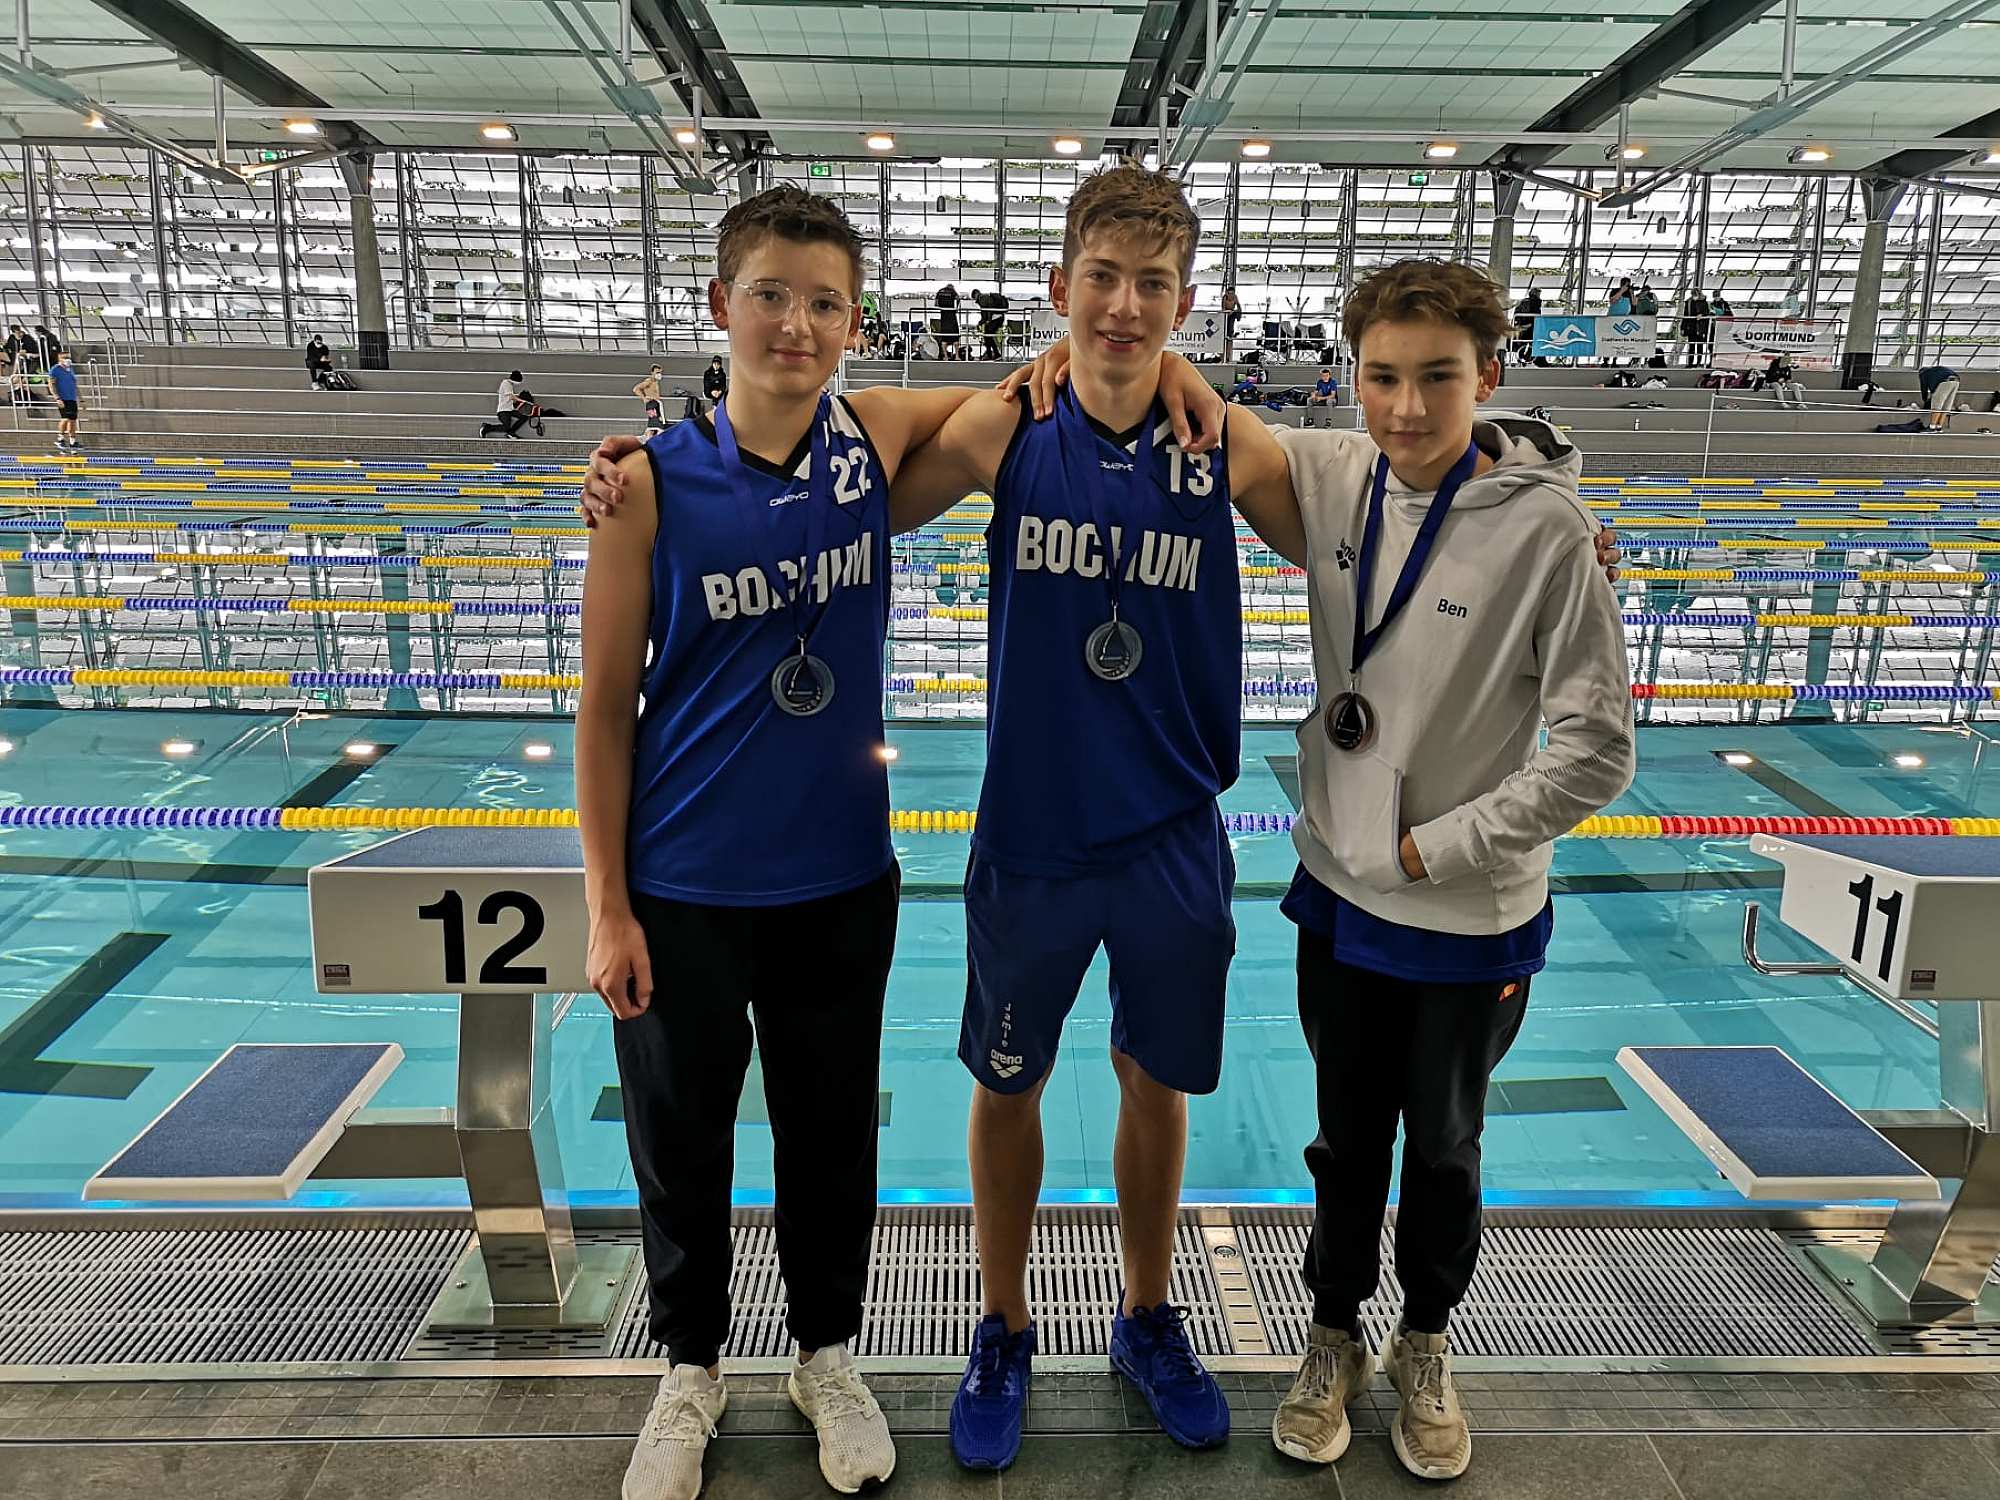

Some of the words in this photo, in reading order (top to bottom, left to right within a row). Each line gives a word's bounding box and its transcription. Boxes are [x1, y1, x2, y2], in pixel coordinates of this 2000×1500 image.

[1745, 331, 1815, 343] DORTMUND
[830, 446, 872, 504] 22
[1166, 445, 1213, 496] 13
[1437, 598, 1468, 618] Ben
[419, 890, 547, 984] 12
[1848, 873, 1903, 983] 11
[990, 1049, 1023, 1065] arena
